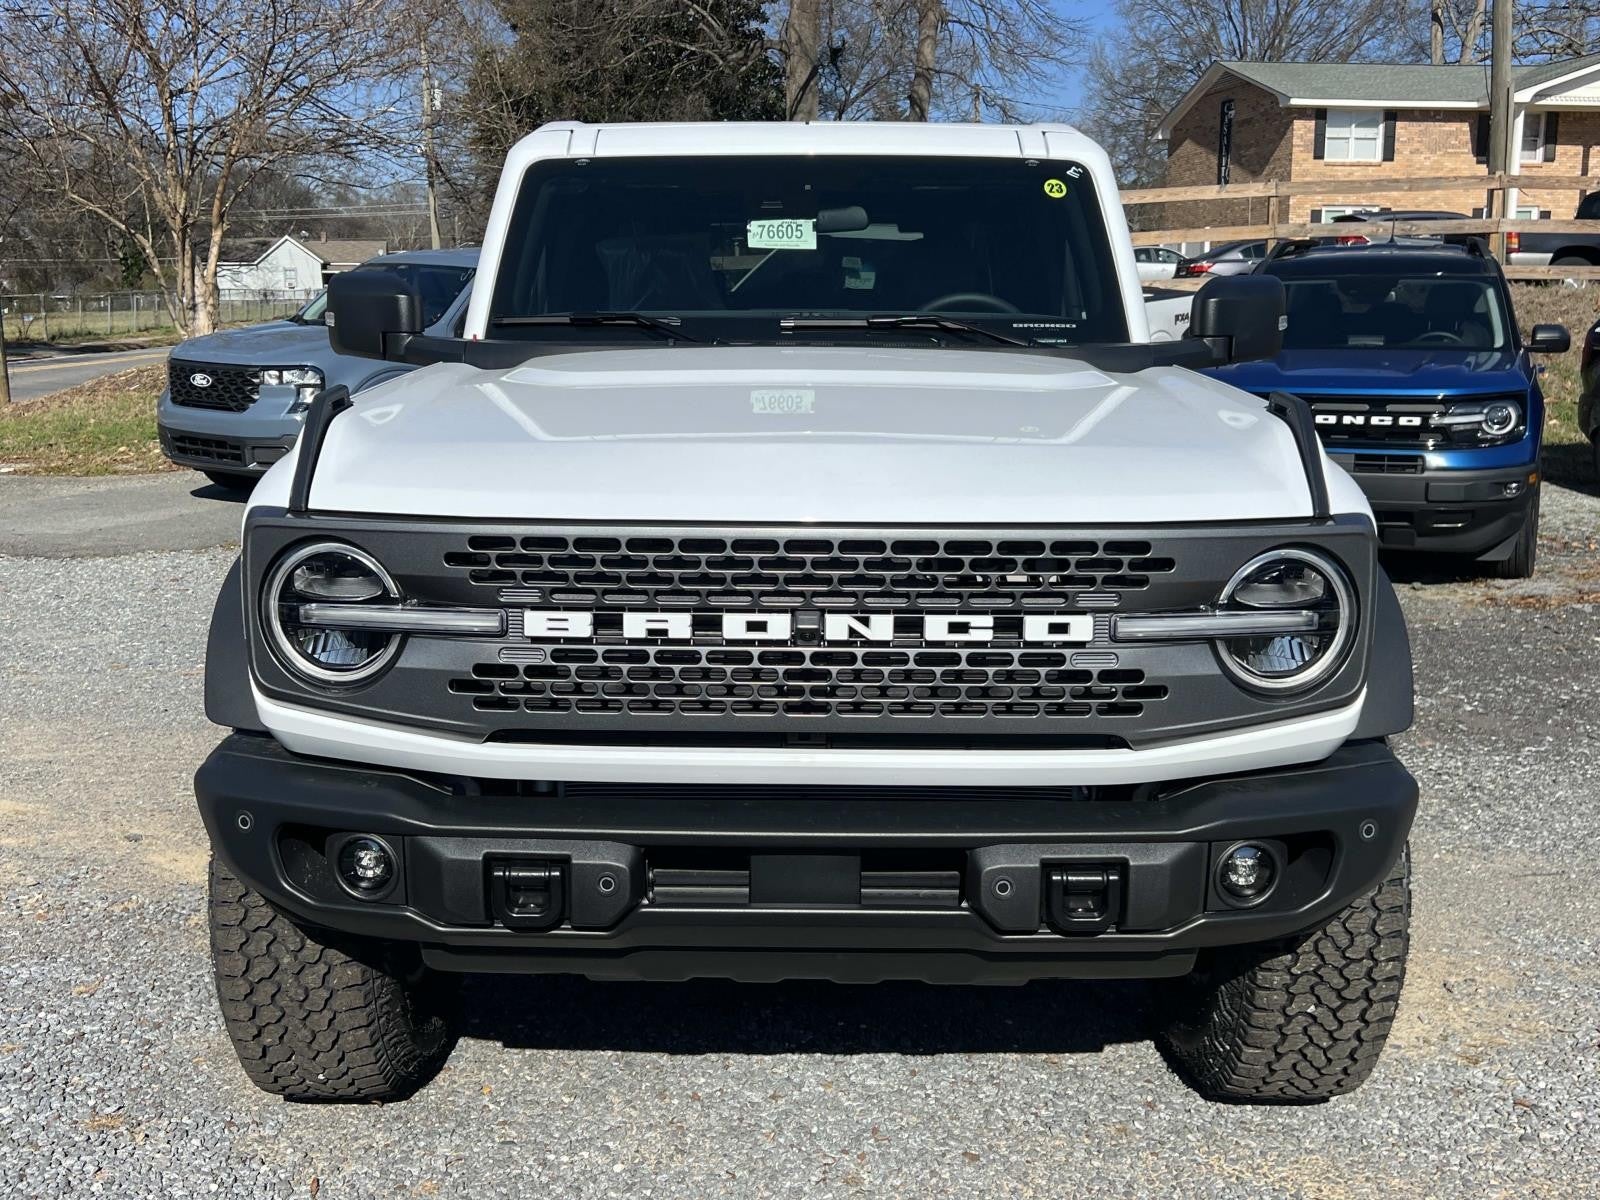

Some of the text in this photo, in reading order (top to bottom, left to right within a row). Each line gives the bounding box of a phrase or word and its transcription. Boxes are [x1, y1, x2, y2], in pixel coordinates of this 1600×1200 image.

[1046, 182, 1064, 194] 23
[757, 223, 804, 240] 76605
[1314, 414, 1422, 426] ONCO
[523, 610, 1094, 642] BRONCO
